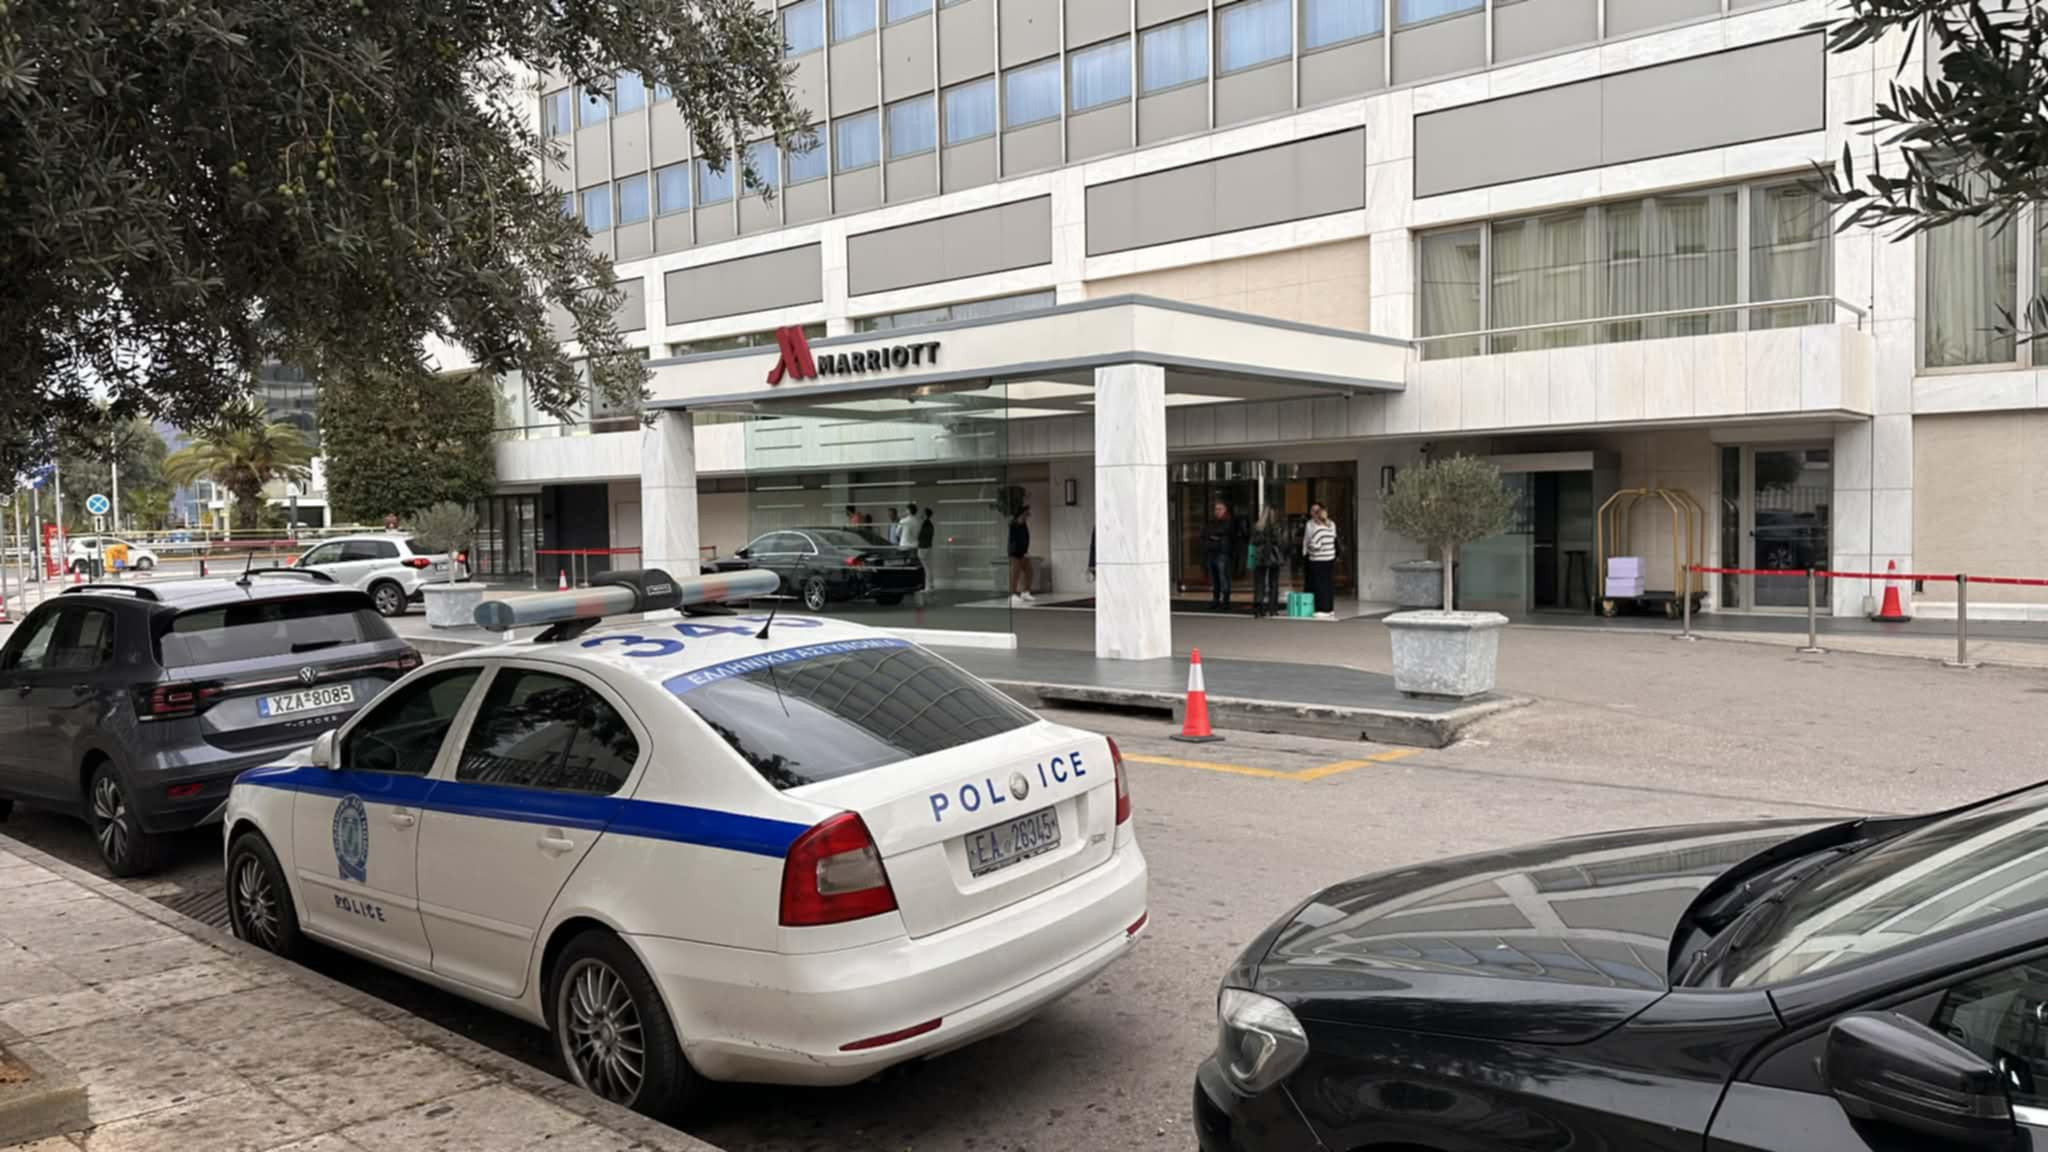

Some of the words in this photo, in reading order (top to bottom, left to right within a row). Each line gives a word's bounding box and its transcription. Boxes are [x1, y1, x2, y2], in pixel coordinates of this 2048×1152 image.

[818, 341, 940, 376] MARRIOTT
[687, 653, 794, 686] ΕΛΛΗΝΙΚΗ
[334, 894, 386, 922] POLICE
